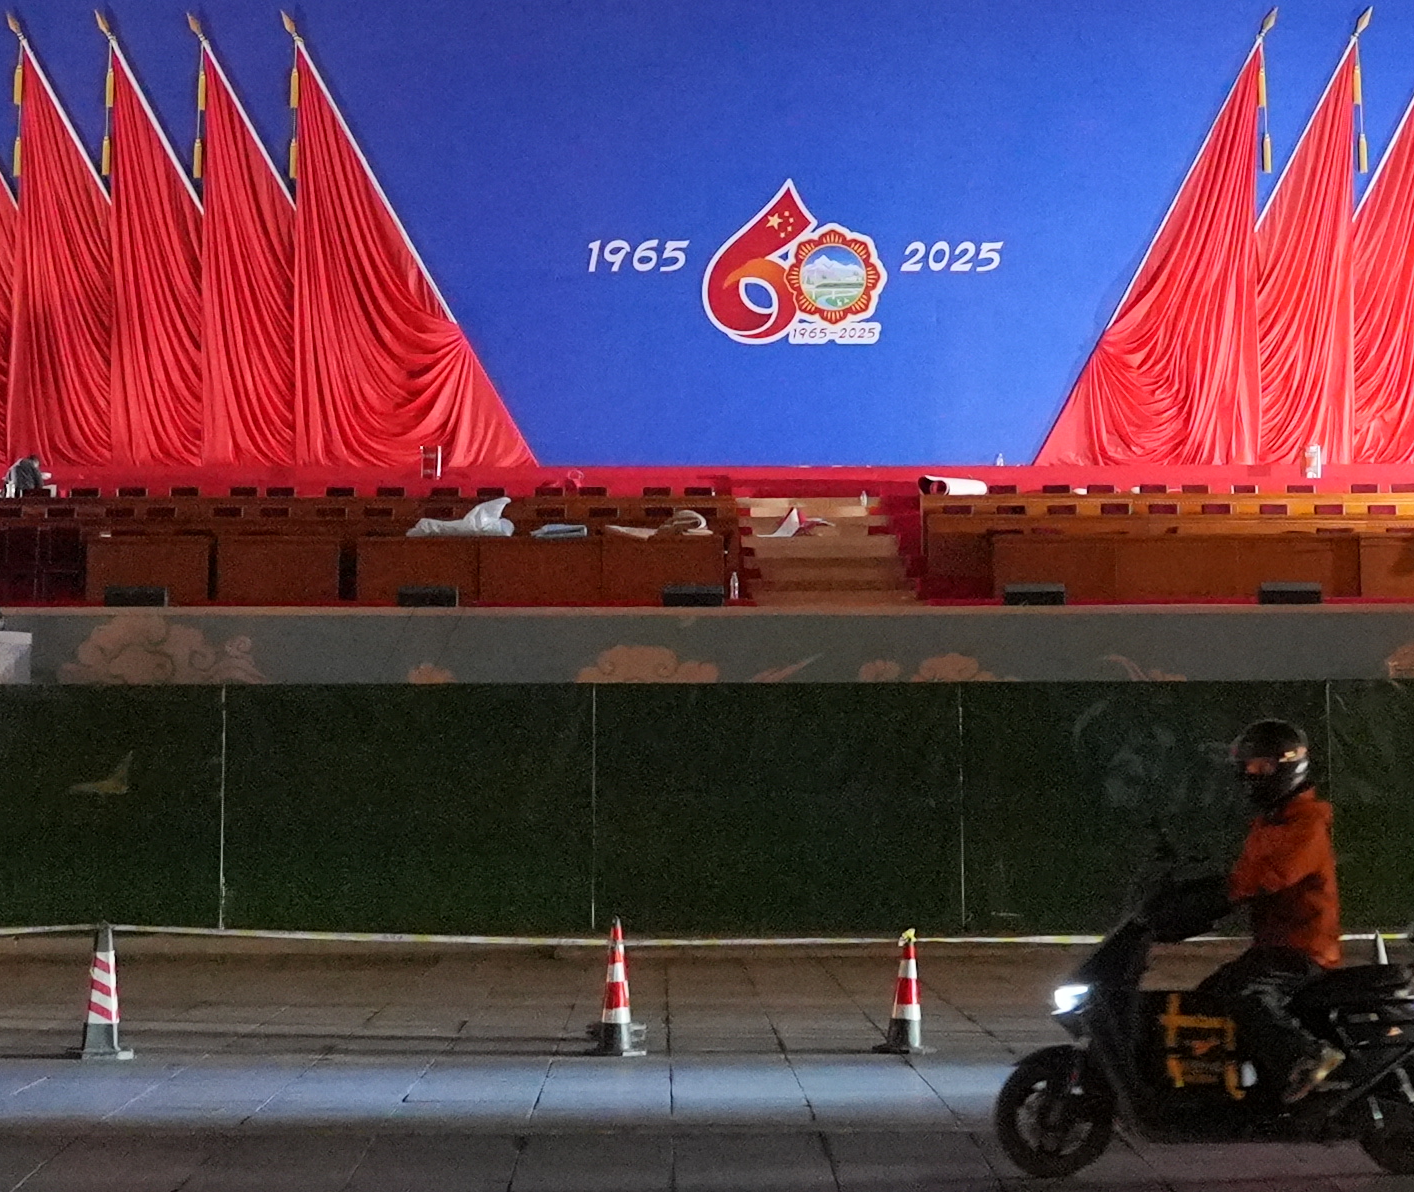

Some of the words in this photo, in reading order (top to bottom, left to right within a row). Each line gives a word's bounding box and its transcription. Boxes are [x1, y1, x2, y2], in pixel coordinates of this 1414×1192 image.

[587, 238, 691, 273] 1965
[900, 240, 1004, 272] 2025
[791, 325, 877, 340] 1965-2025
